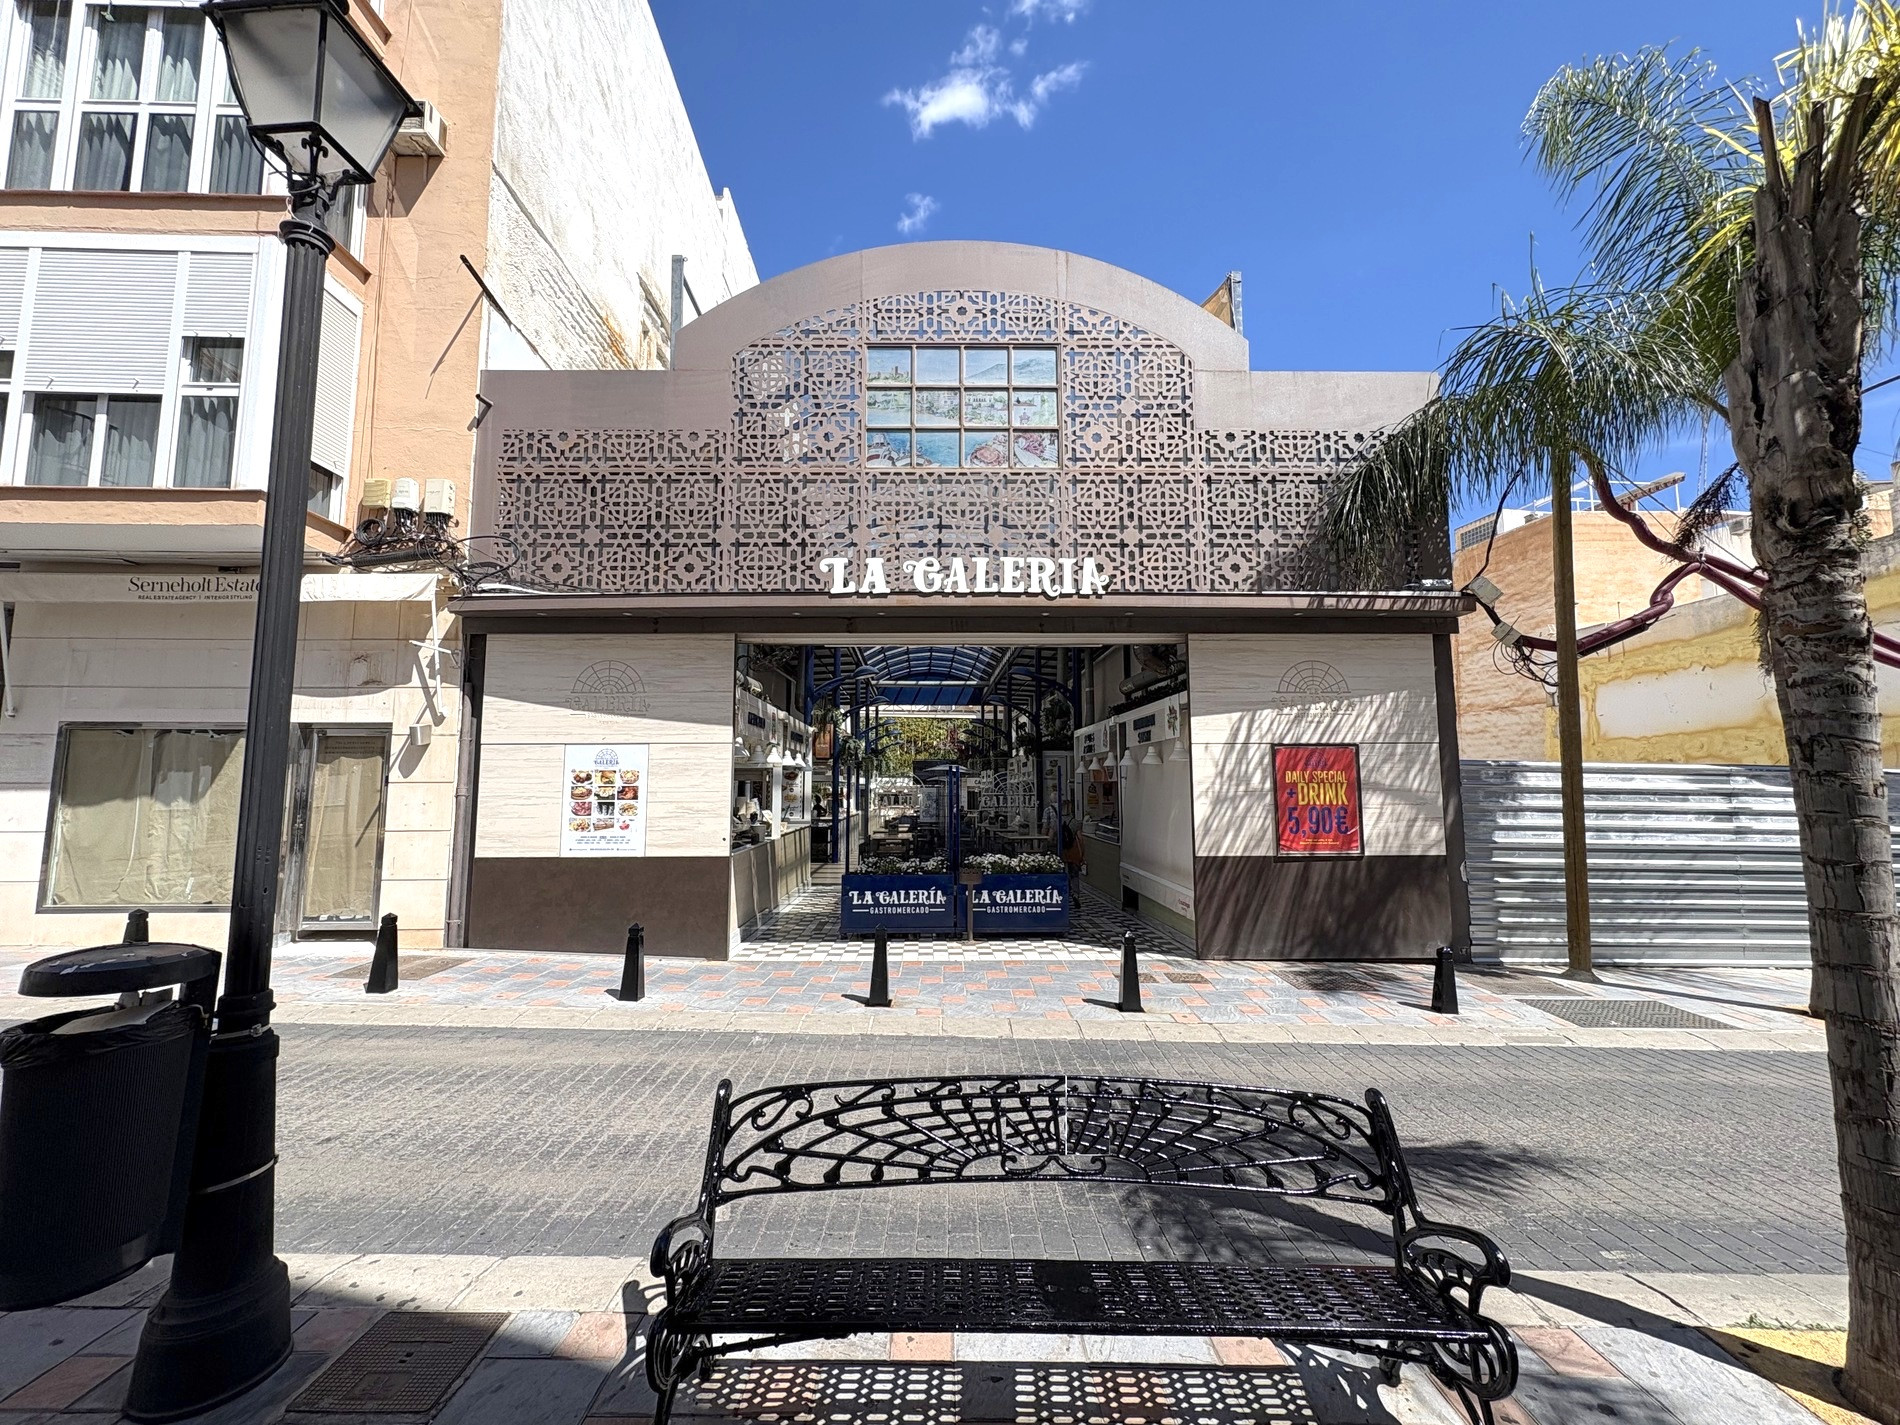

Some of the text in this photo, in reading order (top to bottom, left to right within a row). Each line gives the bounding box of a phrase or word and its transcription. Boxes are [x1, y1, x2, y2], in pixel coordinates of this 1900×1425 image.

[128, 576, 211, 592] Serneholt
[819, 556, 1110, 597] LA GALERIA
[1285, 771, 1347, 783] DAILY SPECIAL
[1287, 806, 1349, 838] 5,90€
[849, 887, 946, 904] LA GALERÍA
[992, 887, 1063, 904] GALERÍA
[870, 906, 929, 914] GASTROMERCADO
[987, 906, 1046, 914] GASTROMERCADO
